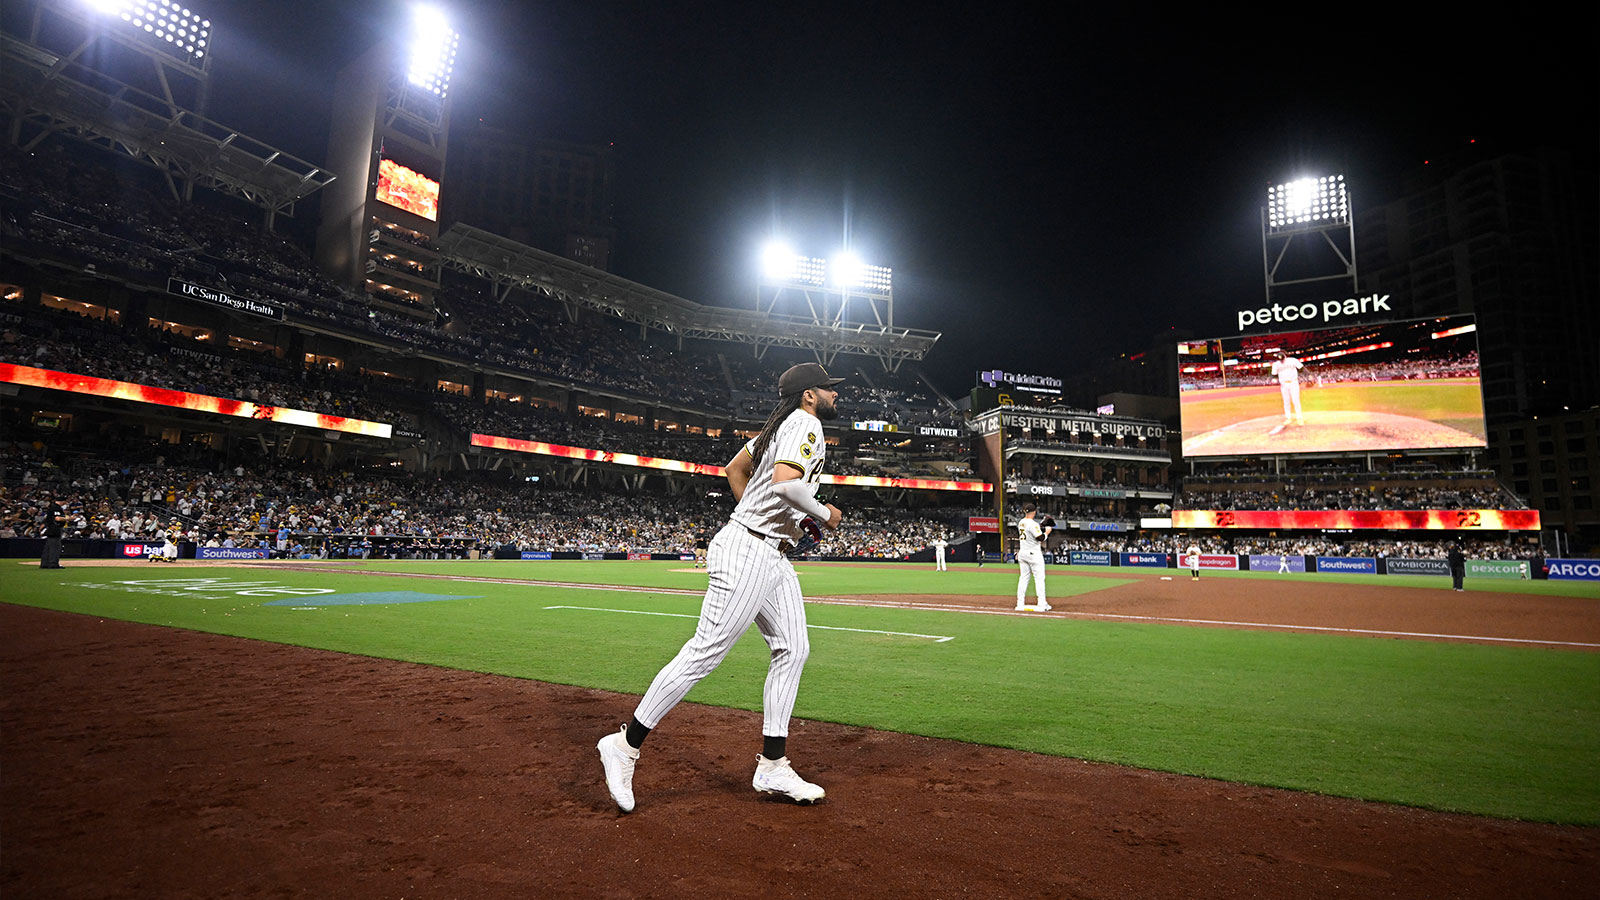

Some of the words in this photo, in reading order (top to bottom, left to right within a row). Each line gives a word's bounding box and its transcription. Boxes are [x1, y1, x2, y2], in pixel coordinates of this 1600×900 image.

[182, 284, 199, 297] UC
[199, 288, 218, 301] San
[219, 293, 245, 308] Diego
[245, 300, 274, 316] Health
[1238, 303, 1318, 331] petco
[1323, 293, 1391, 322] park
[1001, 414, 1056, 430] WESTERN
[1061, 419, 1098, 433] METAL
[1101, 422, 1143, 437] SUPPLY
[1147, 426, 1165, 438] CO.
[920, 426, 958, 437] CUTWATER
[1030, 485, 1053, 495] ORIS
[125, 546, 141, 554] us
[143, 545, 163, 555] ba
[203, 549, 256, 558] Southwest
[1055, 556, 1068, 564] 342
[1081, 553, 1108, 561] Palomar
[1139, 555, 1157, 563] bank
[1199, 559, 1231, 567] napdragon
[1320, 560, 1366, 569] Southwest
[1549, 563, 1600, 576] ARCO
